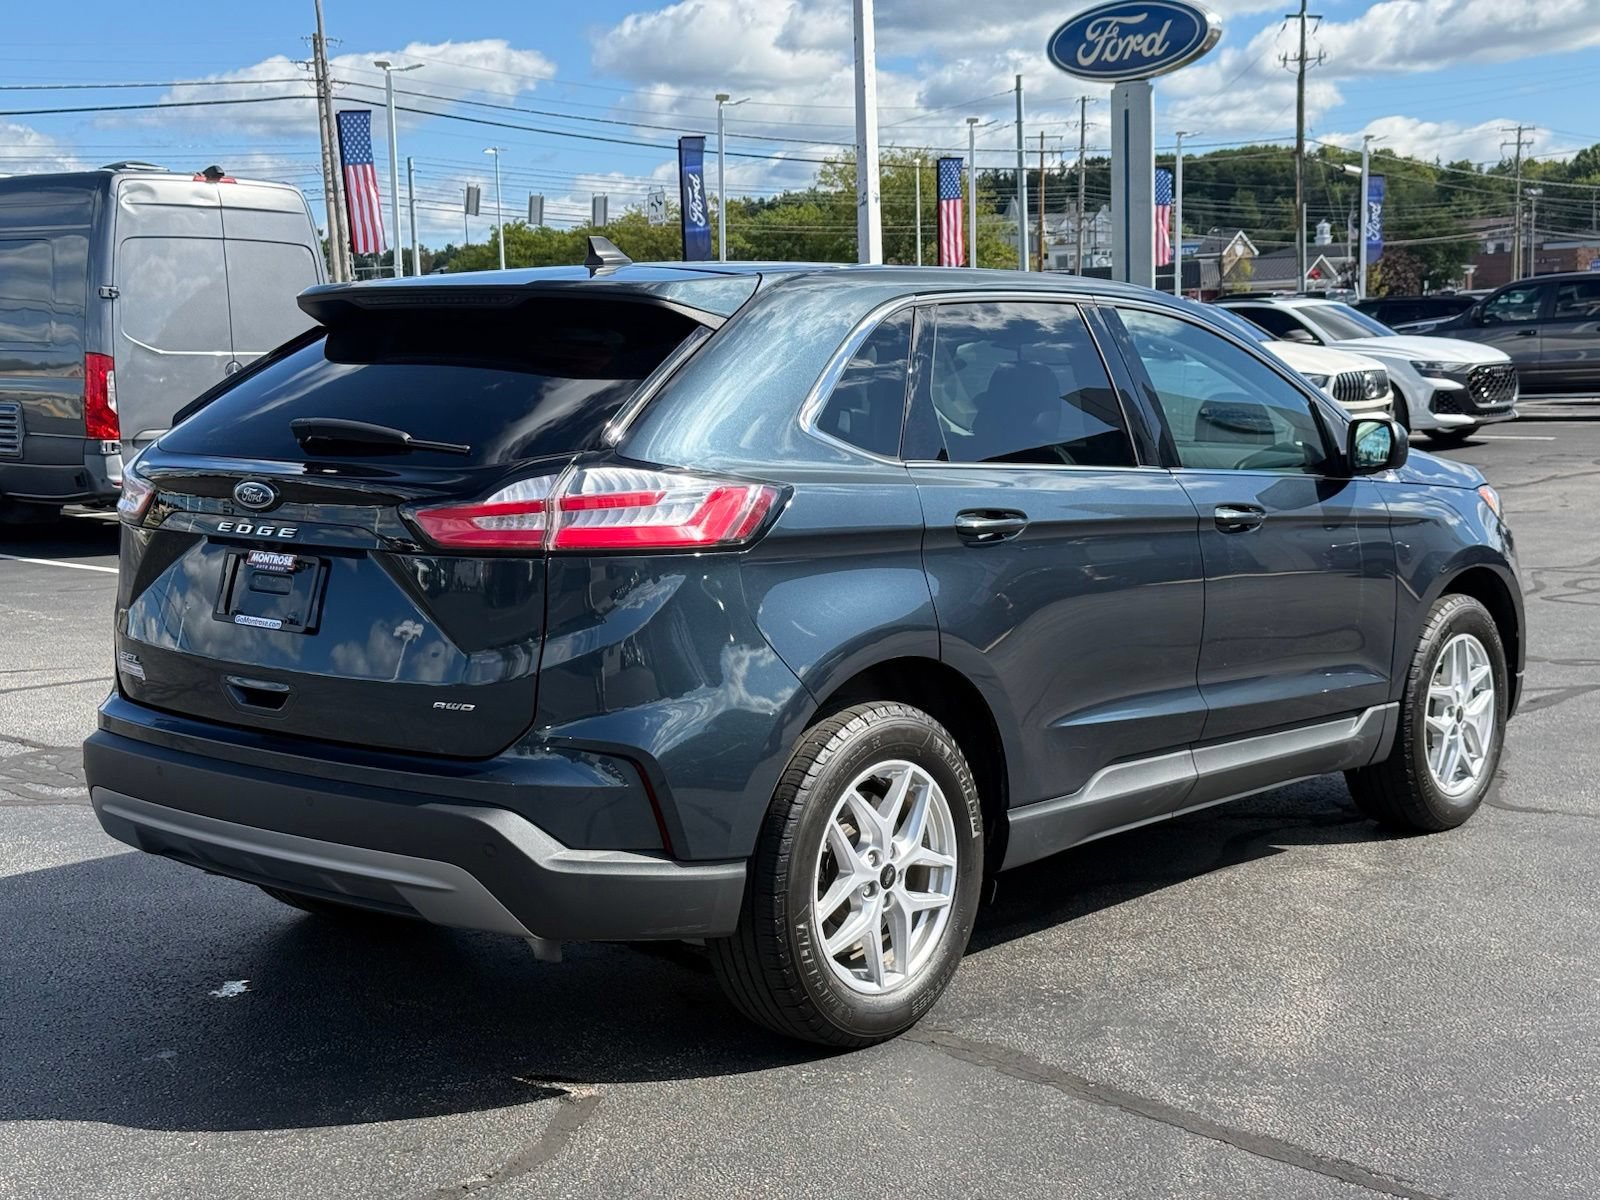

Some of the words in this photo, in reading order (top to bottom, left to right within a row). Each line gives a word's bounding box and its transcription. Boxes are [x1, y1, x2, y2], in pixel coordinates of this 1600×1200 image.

[1076, 13, 1172, 66] Ford
[687, 174, 706, 227] Ford
[241, 487, 265, 503] Ford
[217, 522, 298, 538] EDGE
[250, 552, 294, 566] MONTROSE
[235, 616, 281, 628] GoMontrose.com
[119, 651, 140, 663] SEL
[433, 702, 476, 711] AWD
